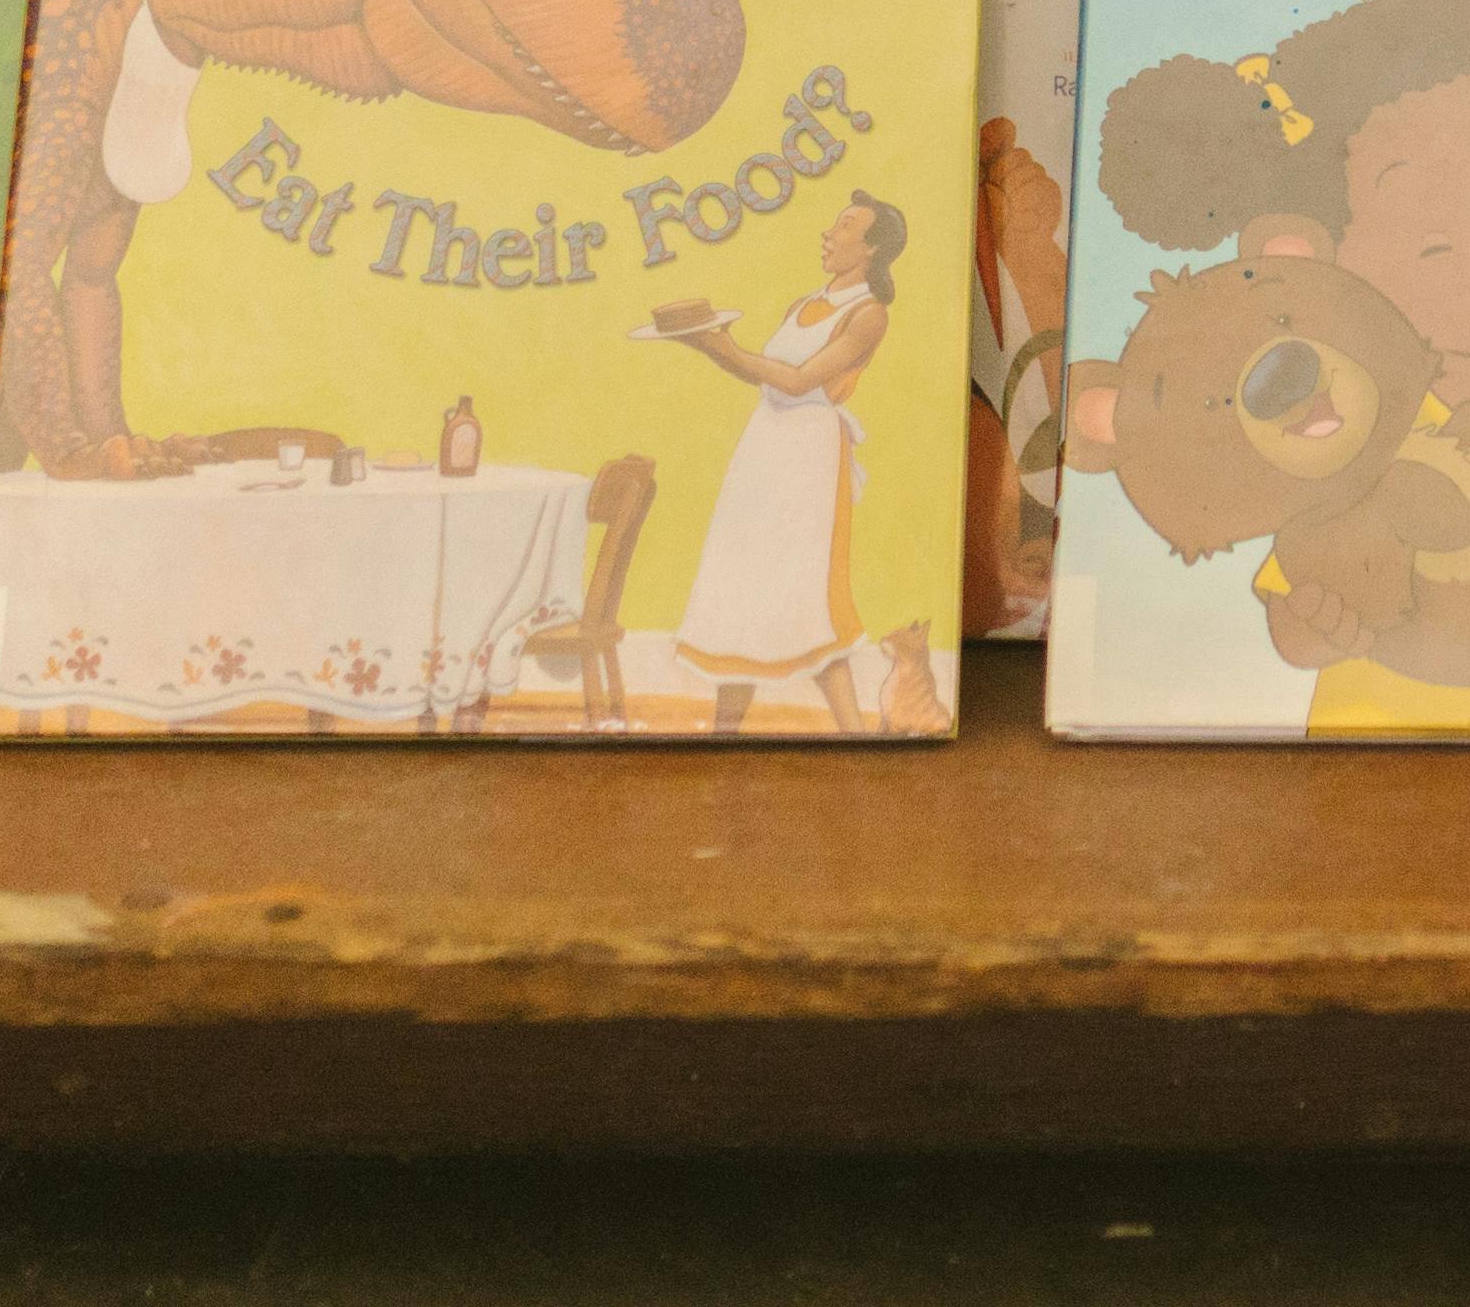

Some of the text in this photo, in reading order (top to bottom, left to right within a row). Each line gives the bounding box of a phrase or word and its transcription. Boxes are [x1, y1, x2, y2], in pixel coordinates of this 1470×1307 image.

[205, 63, 876, 292] Eat Their Food?
